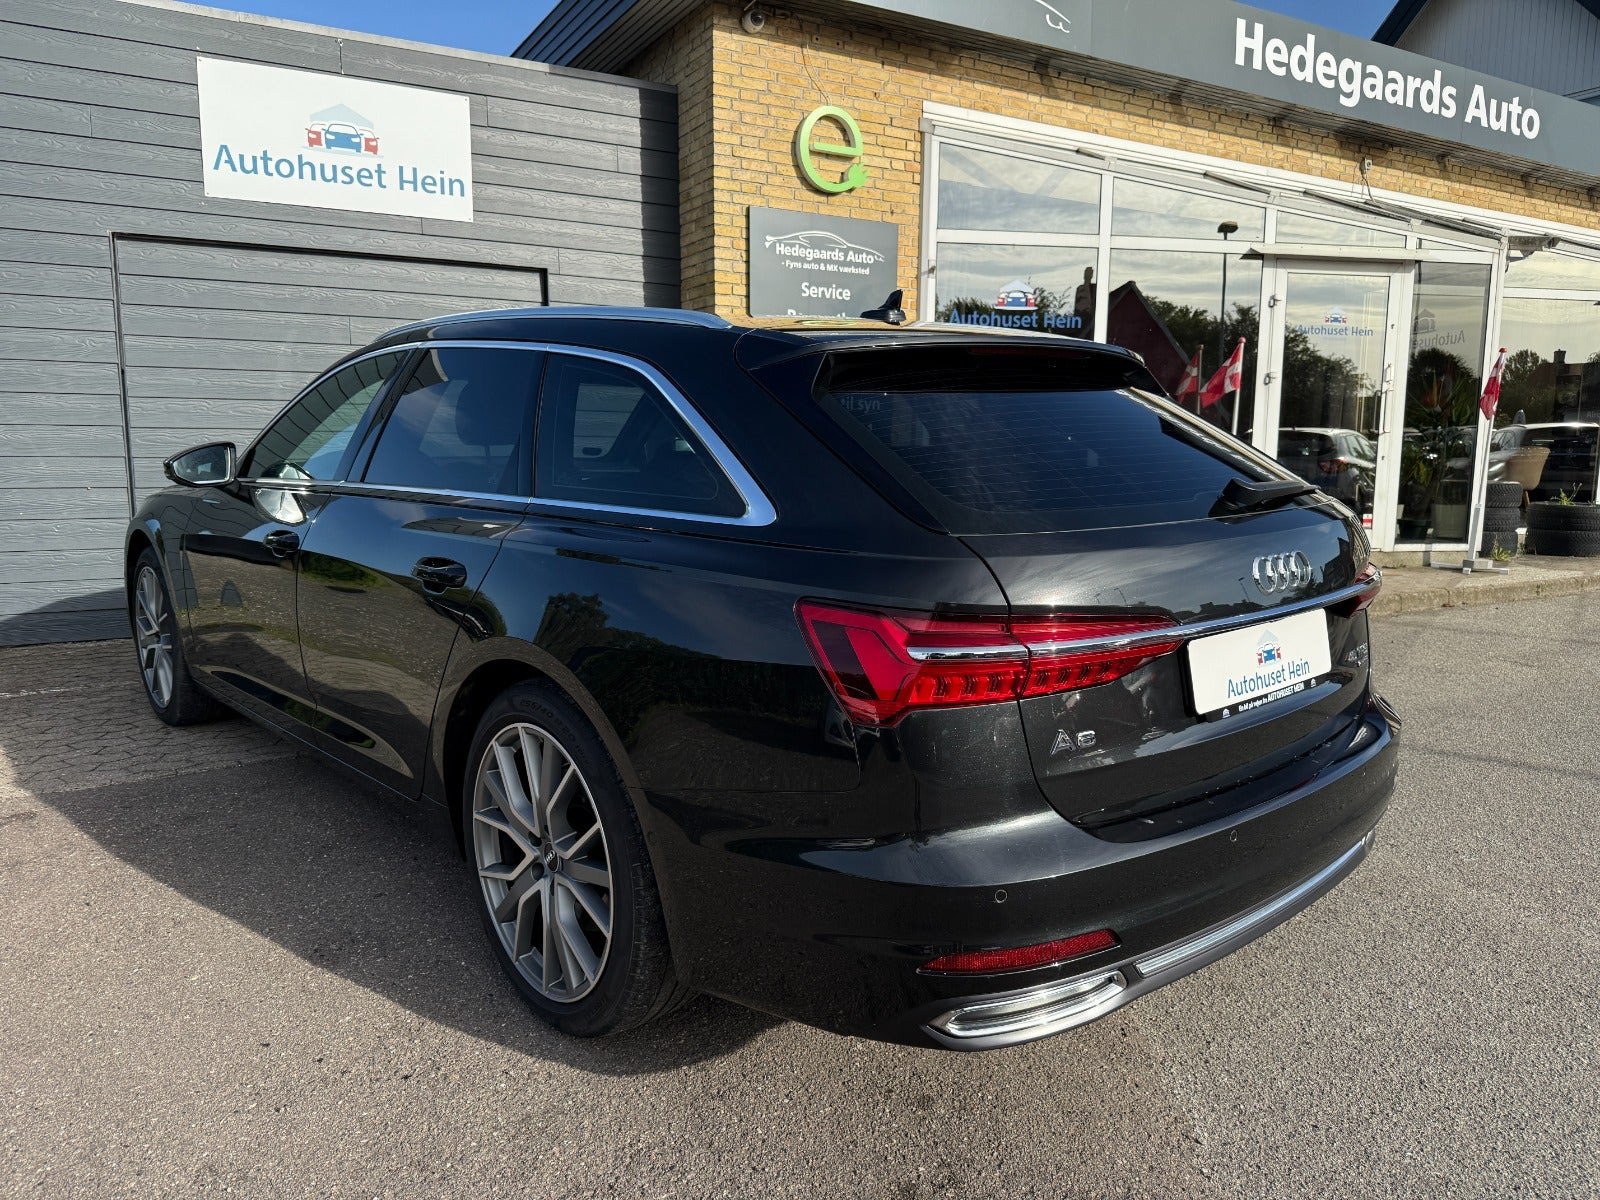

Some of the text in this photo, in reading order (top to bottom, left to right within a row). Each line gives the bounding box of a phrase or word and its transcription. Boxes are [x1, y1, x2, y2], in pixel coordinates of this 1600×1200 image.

[1234, 17, 1541, 140] Hedegaards Auto
[212, 143, 466, 198] Autohuset Hein
[775, 242, 875, 264] Hedegaards Auto
[785, 259, 802, 269] Fyns
[803, 262, 819, 270] auto
[820, 263, 826, 271] &
[826, 263, 839, 272] MX
[801, 282, 851, 301] Service
[950, 308, 1082, 329] Autohuset Hein
[1297, 324, 1374, 337] Autohuset Hein
[1227, 658, 1310, 699] Autohuset Hein
[1268, 685, 1294, 703] AUTOHUSET
[1050, 729, 1097, 756] A6
